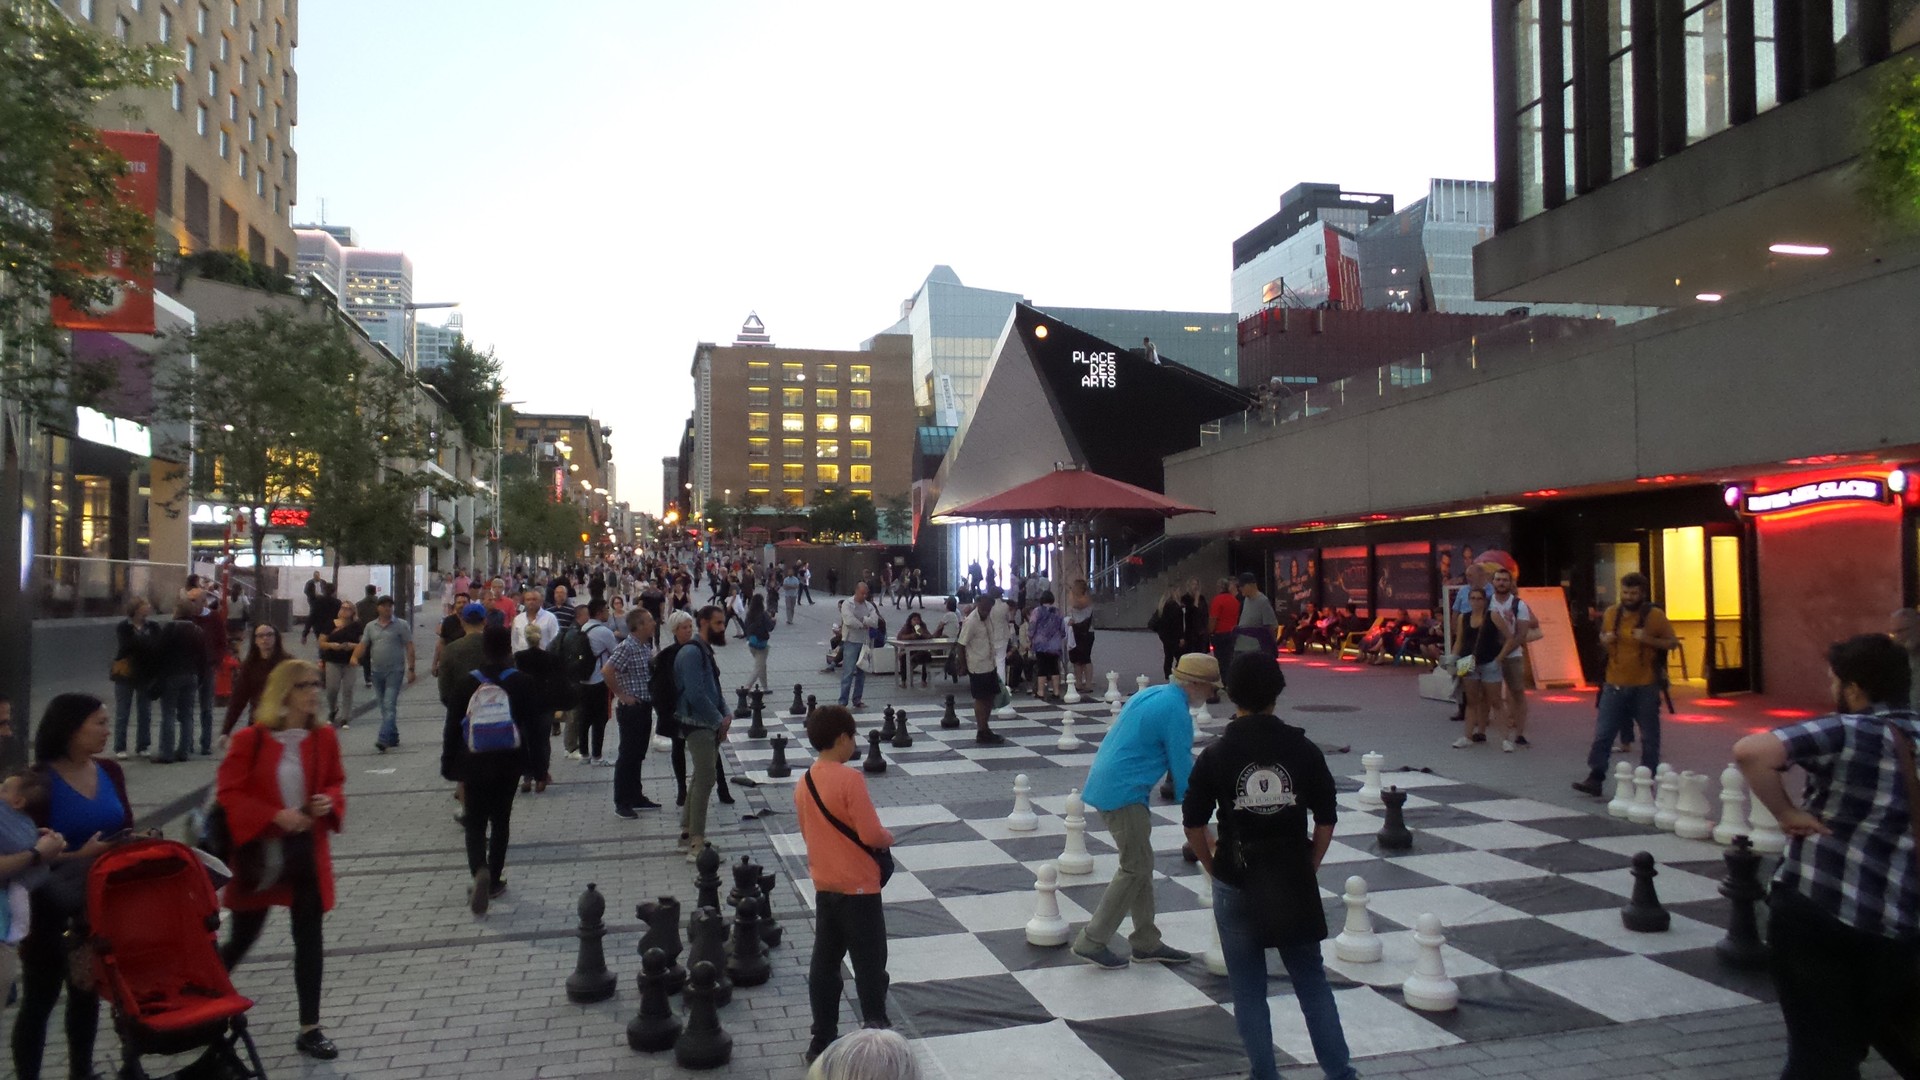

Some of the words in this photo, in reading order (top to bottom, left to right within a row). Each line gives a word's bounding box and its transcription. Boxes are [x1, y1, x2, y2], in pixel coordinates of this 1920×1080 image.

[1072, 350, 1116, 364] PLACE
[1090, 363, 1116, 376] DES
[1081, 375, 1116, 388] ARTS
